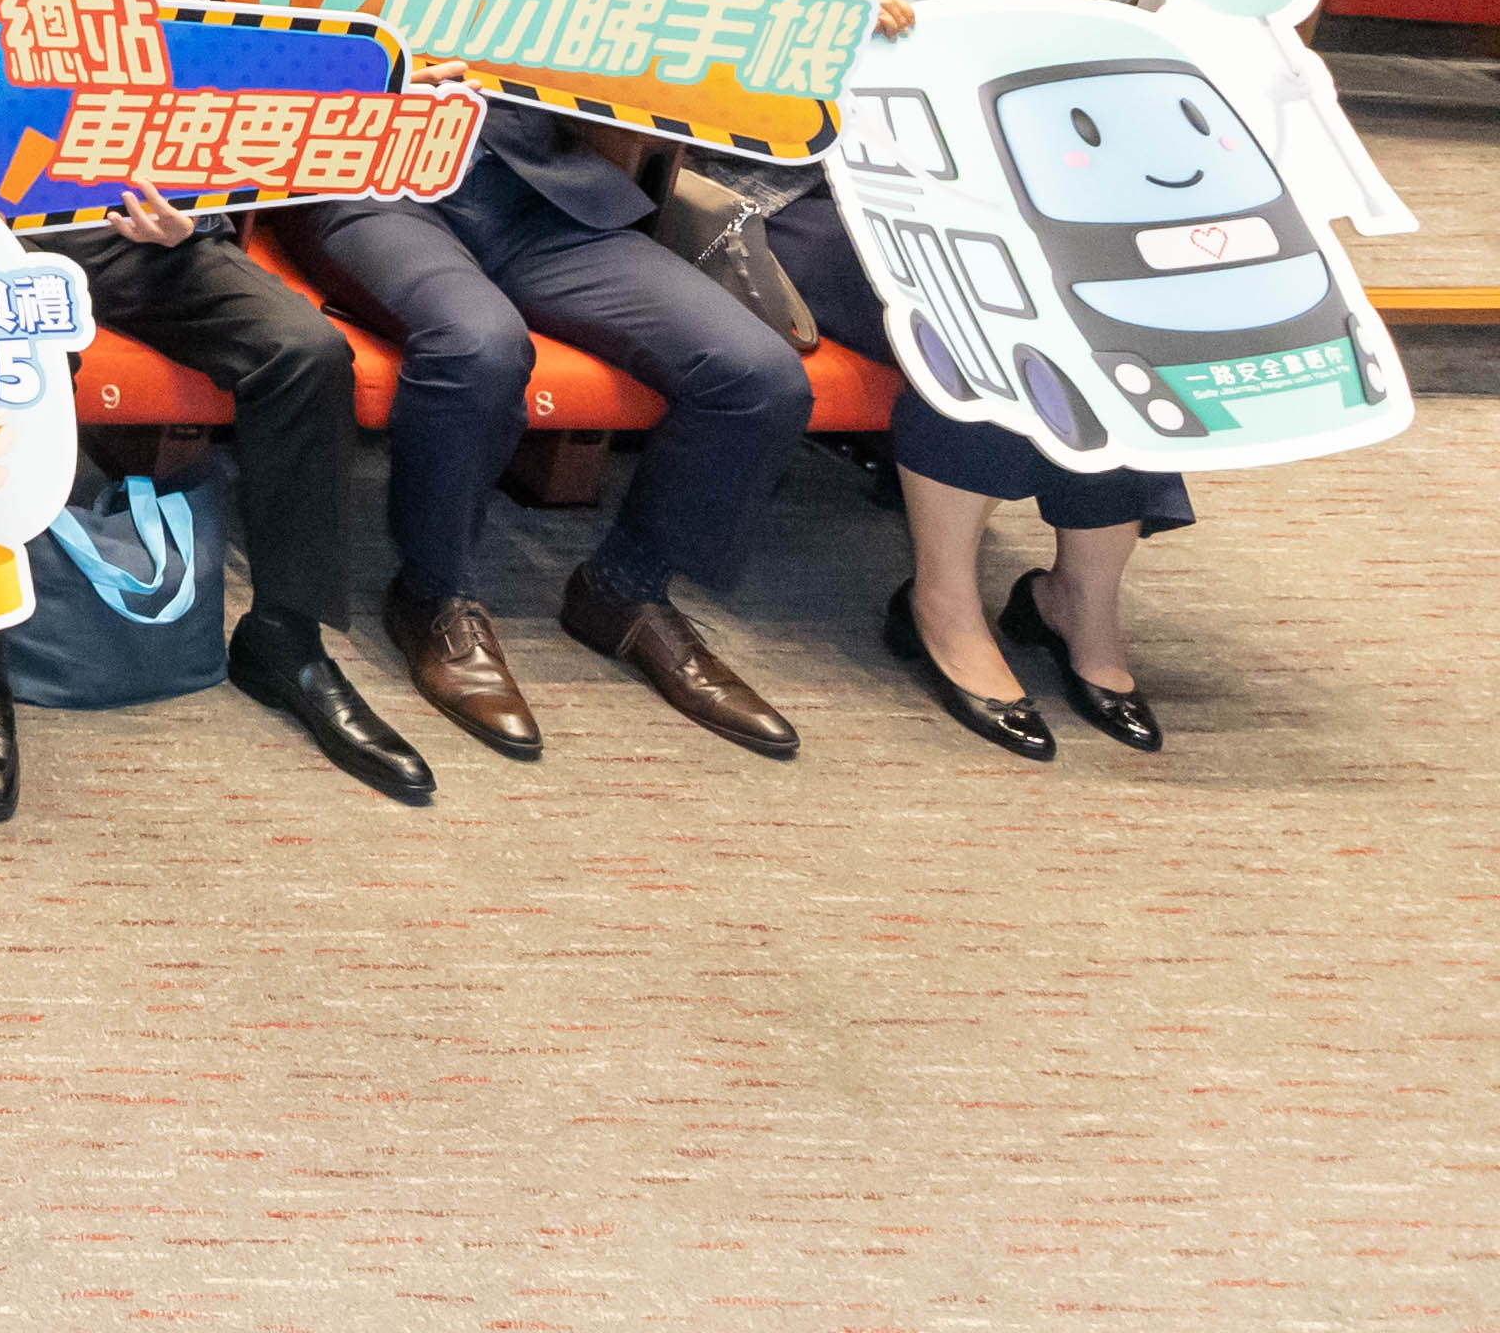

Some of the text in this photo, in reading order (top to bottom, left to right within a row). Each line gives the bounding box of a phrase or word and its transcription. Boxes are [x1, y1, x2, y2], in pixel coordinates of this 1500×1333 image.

[52, 90, 479, 191] 車速要留神
[100, 383, 121, 409] 9
[534, 391, 556, 417] 8
